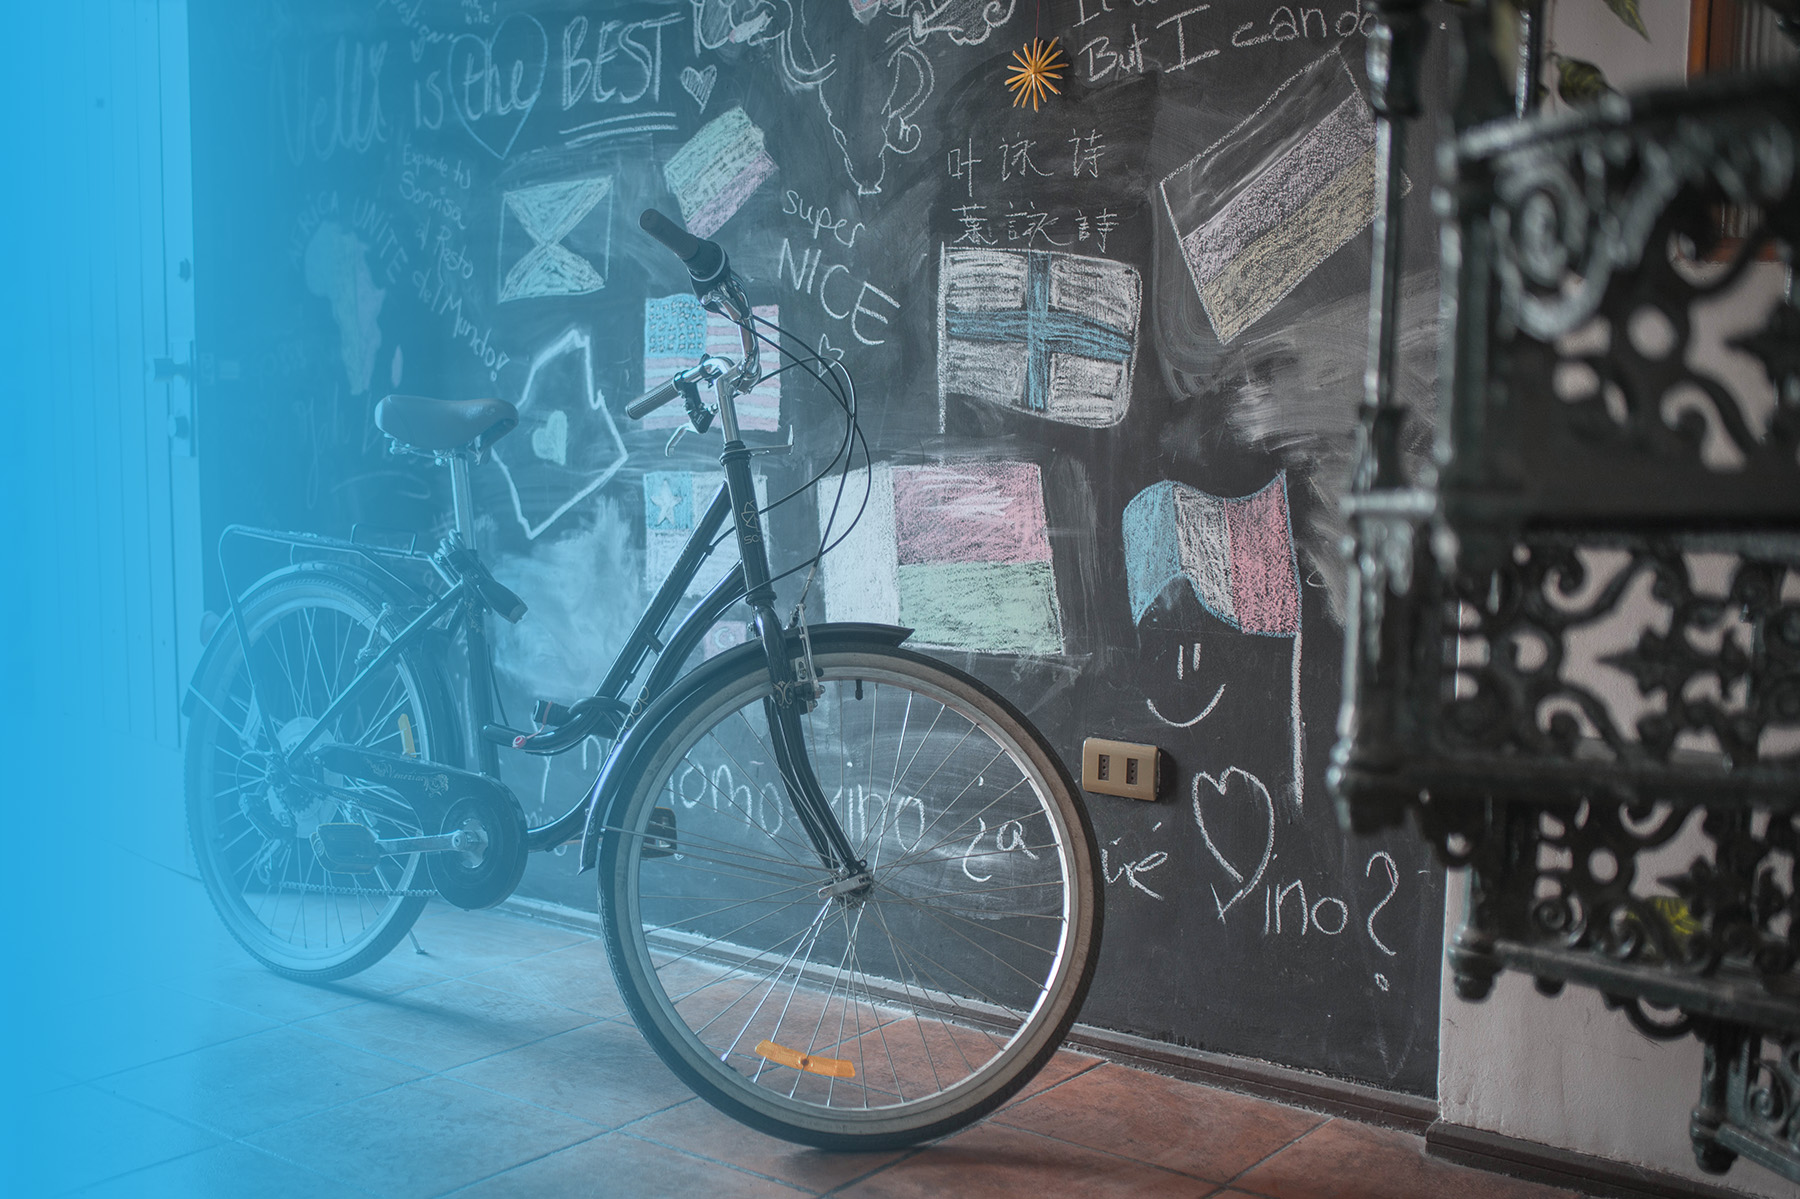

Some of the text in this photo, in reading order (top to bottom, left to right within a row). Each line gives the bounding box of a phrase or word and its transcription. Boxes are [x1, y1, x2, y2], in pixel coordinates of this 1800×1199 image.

[463, 52, 541, 121] the
[562, 12, 686, 111] BEST
[1077, 22, 1149, 83] But
[777, 236, 902, 347] NICE
